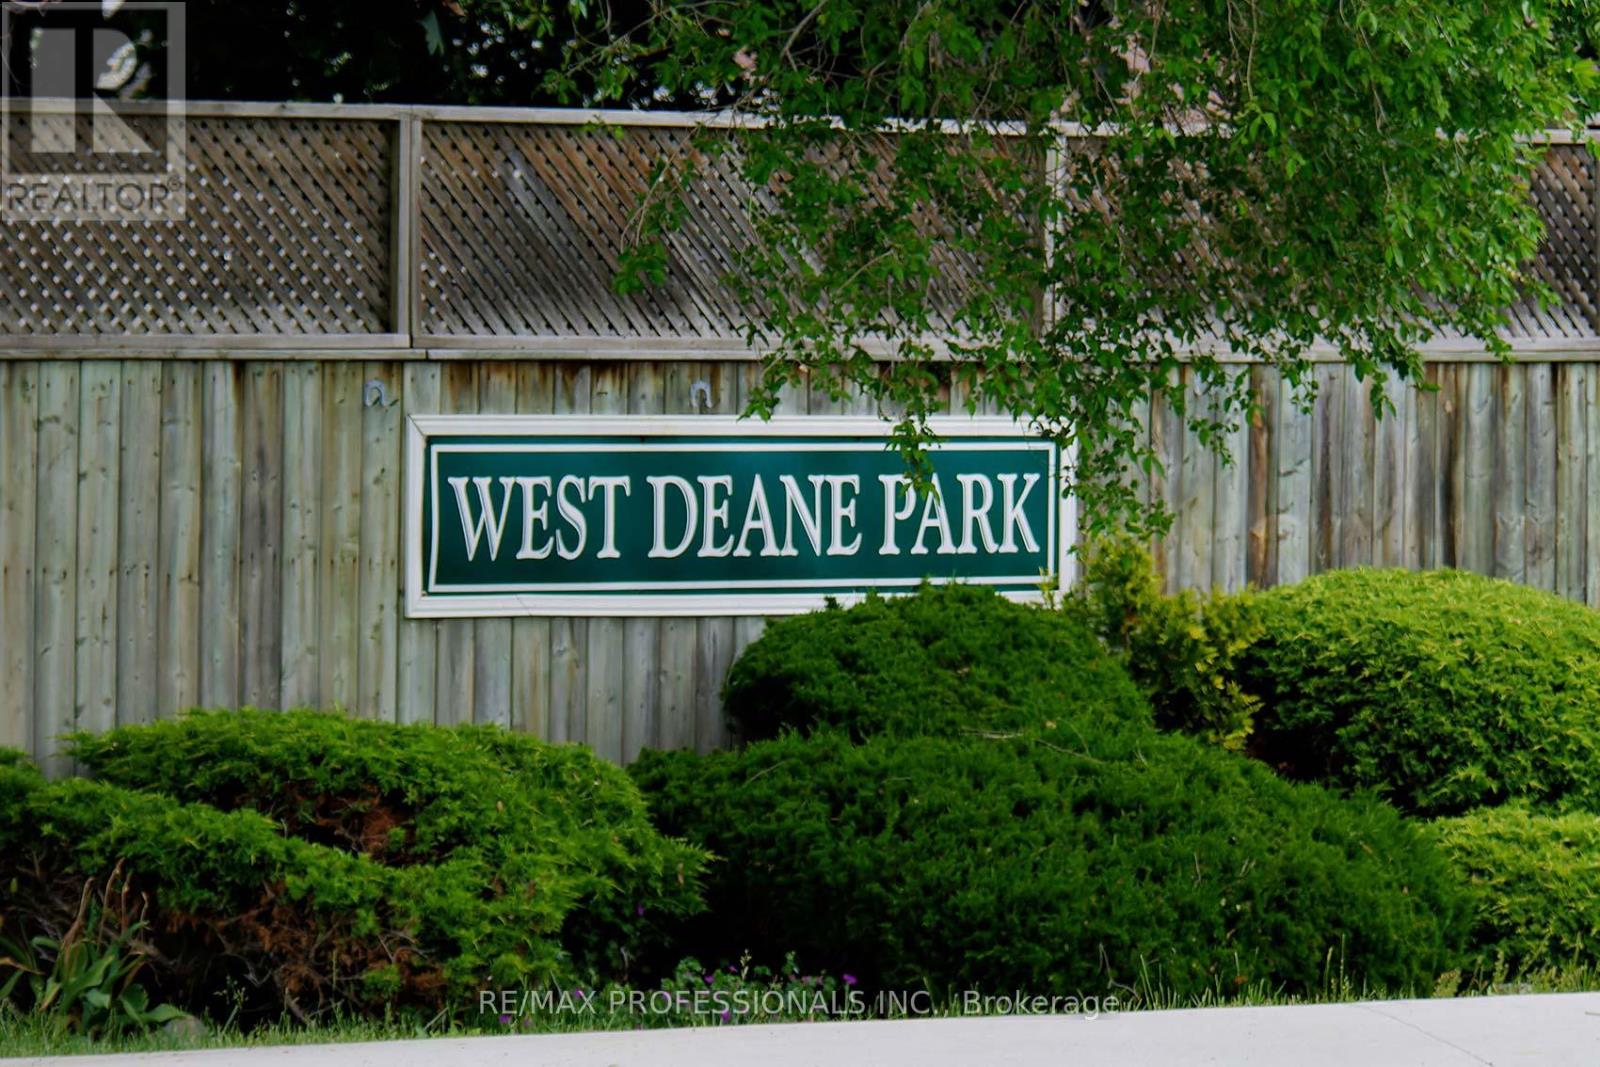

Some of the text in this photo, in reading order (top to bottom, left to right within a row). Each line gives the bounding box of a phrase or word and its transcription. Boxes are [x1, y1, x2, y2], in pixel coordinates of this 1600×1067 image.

[447, 472, 1041, 562] WEST DEANE PARK
